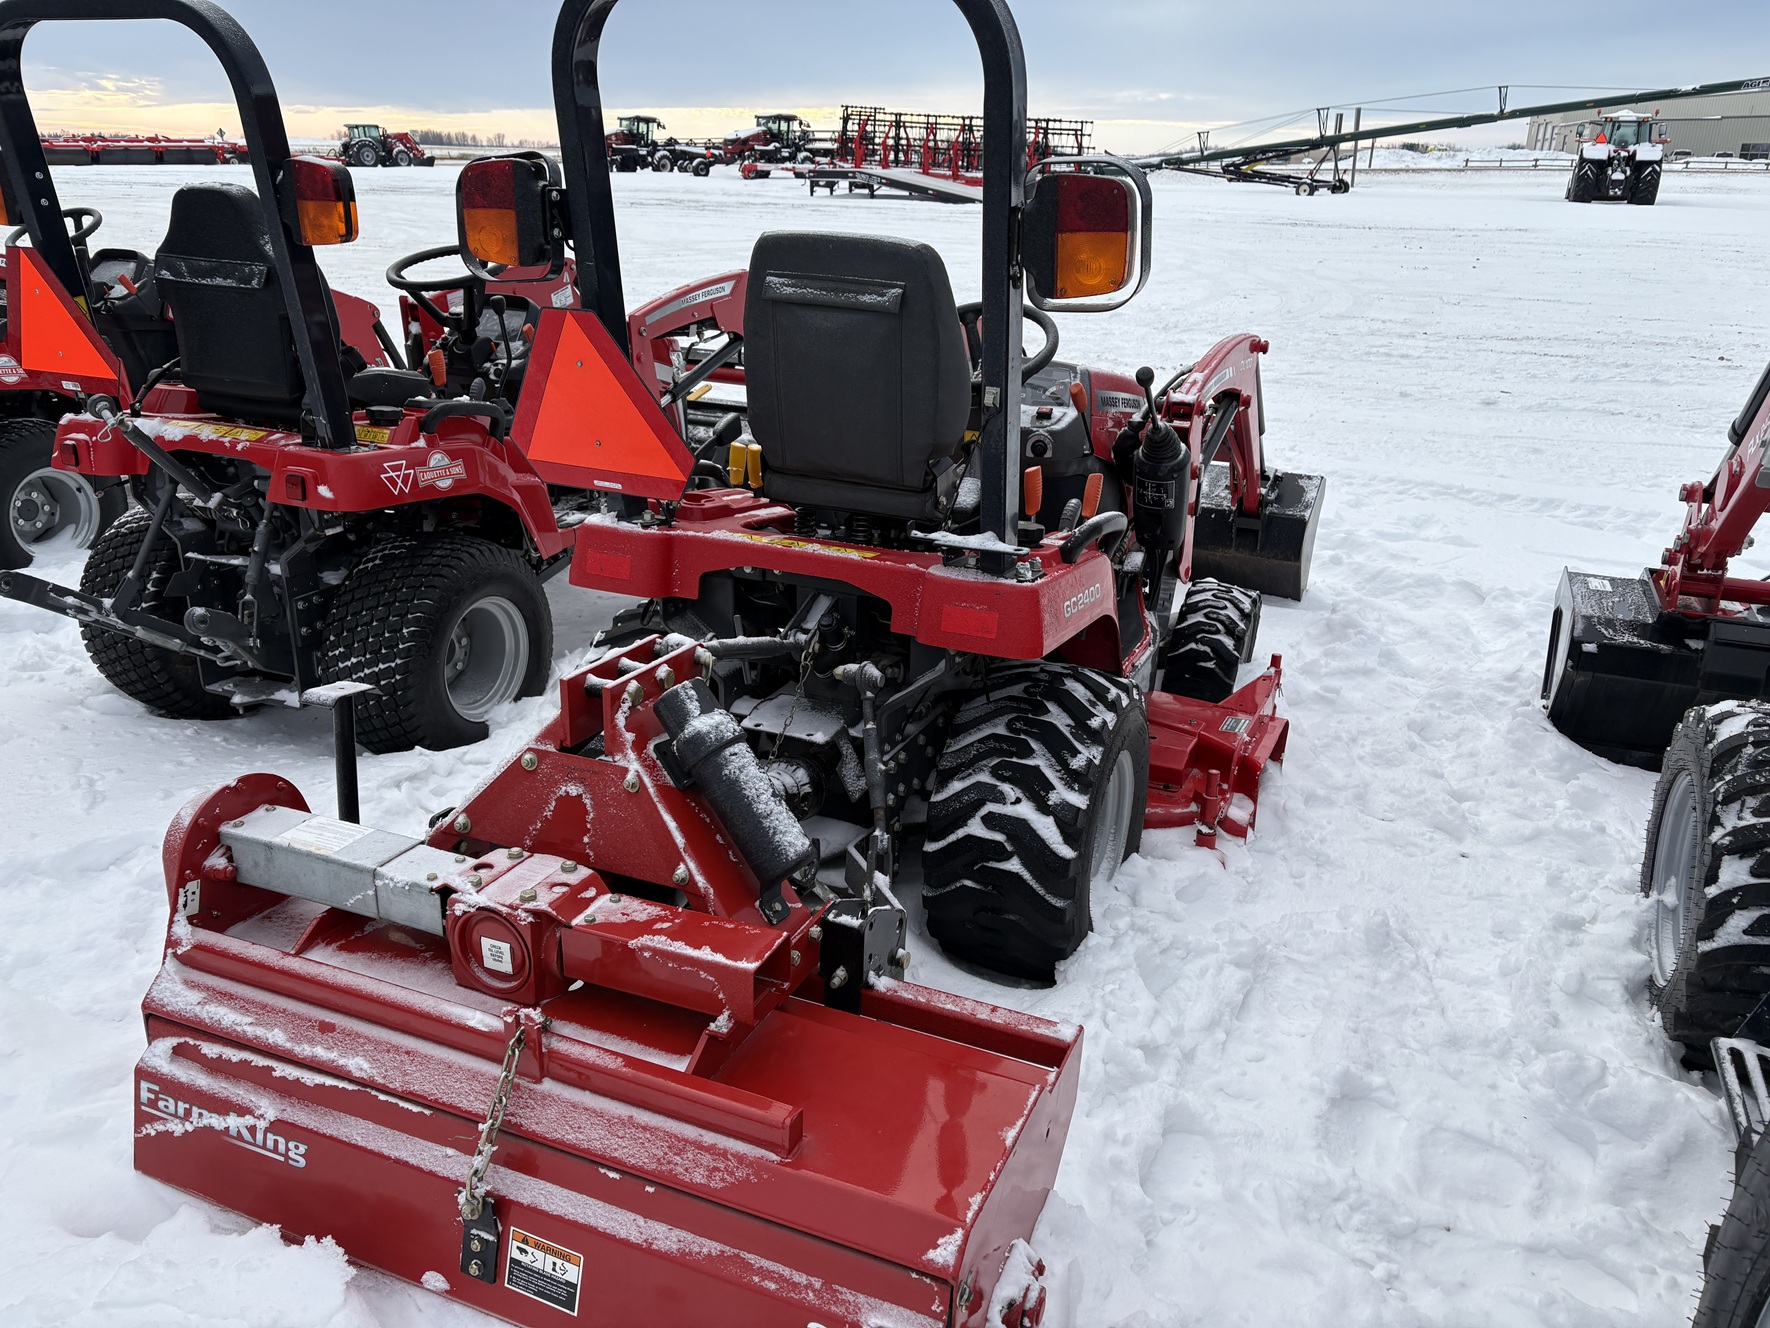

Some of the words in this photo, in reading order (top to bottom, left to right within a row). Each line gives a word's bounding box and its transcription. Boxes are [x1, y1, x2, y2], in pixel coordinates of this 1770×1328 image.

[1742, 80, 1761, 89] AGI
[681, 293, 700, 305] MASSEY
[701, 285, 726, 299] FERGUSON
[1100, 396, 1120, 408] MASSEY
[1121, 397, 1141, 410] FERGUSON
[450, 465, 463, 475] SONS
[1063, 582, 1101, 619] GC2400
[490, 943, 502, 951] CHECK
[534, 1240, 572, 1262] WARNING
